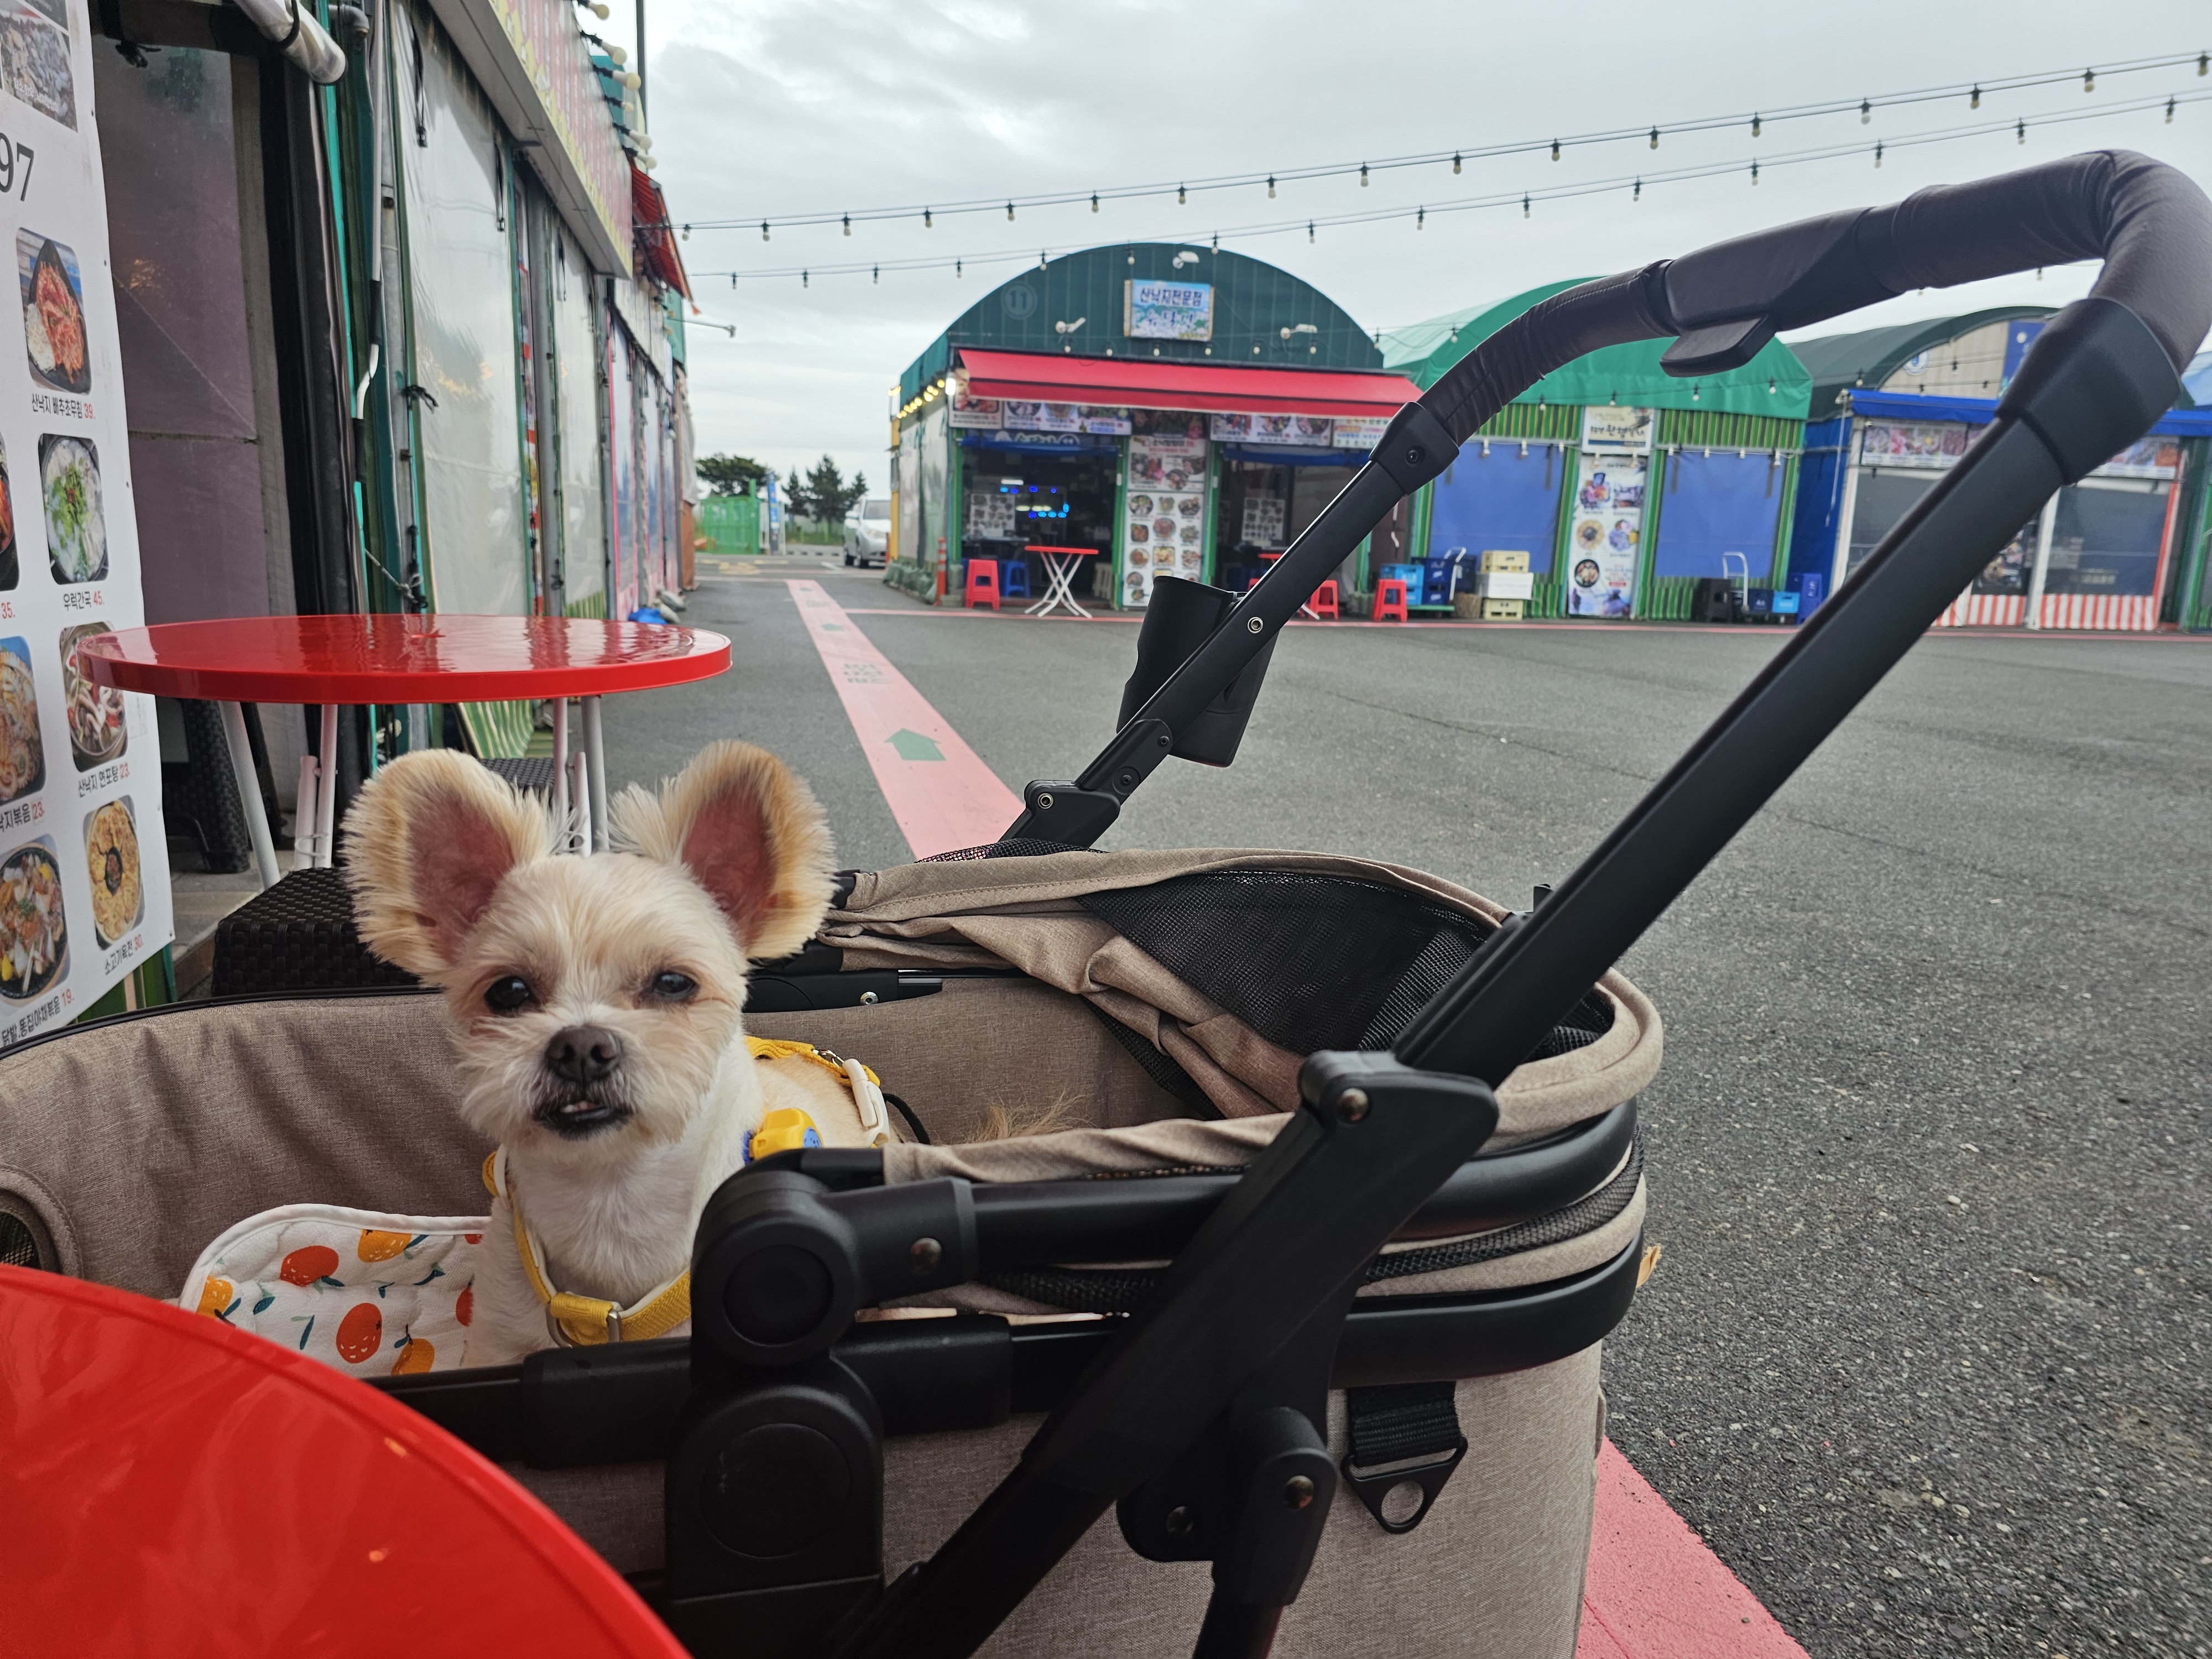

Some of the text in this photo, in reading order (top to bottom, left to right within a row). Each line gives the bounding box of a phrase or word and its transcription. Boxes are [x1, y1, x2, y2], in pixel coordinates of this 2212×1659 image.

[1009, 290, 1027, 310] 11
[1140, 288, 1202, 307] 산낙지전문점
[32, 393, 51, 414] 산낙지
[53, 397, 83, 419] 배추초무침
[63, 591, 92, 612] 우럭간국
[79, 773, 98, 798] 산낙지
[99, 764, 119, 789] 연포탕
[105, 940, 134, 975] 소고기육전
